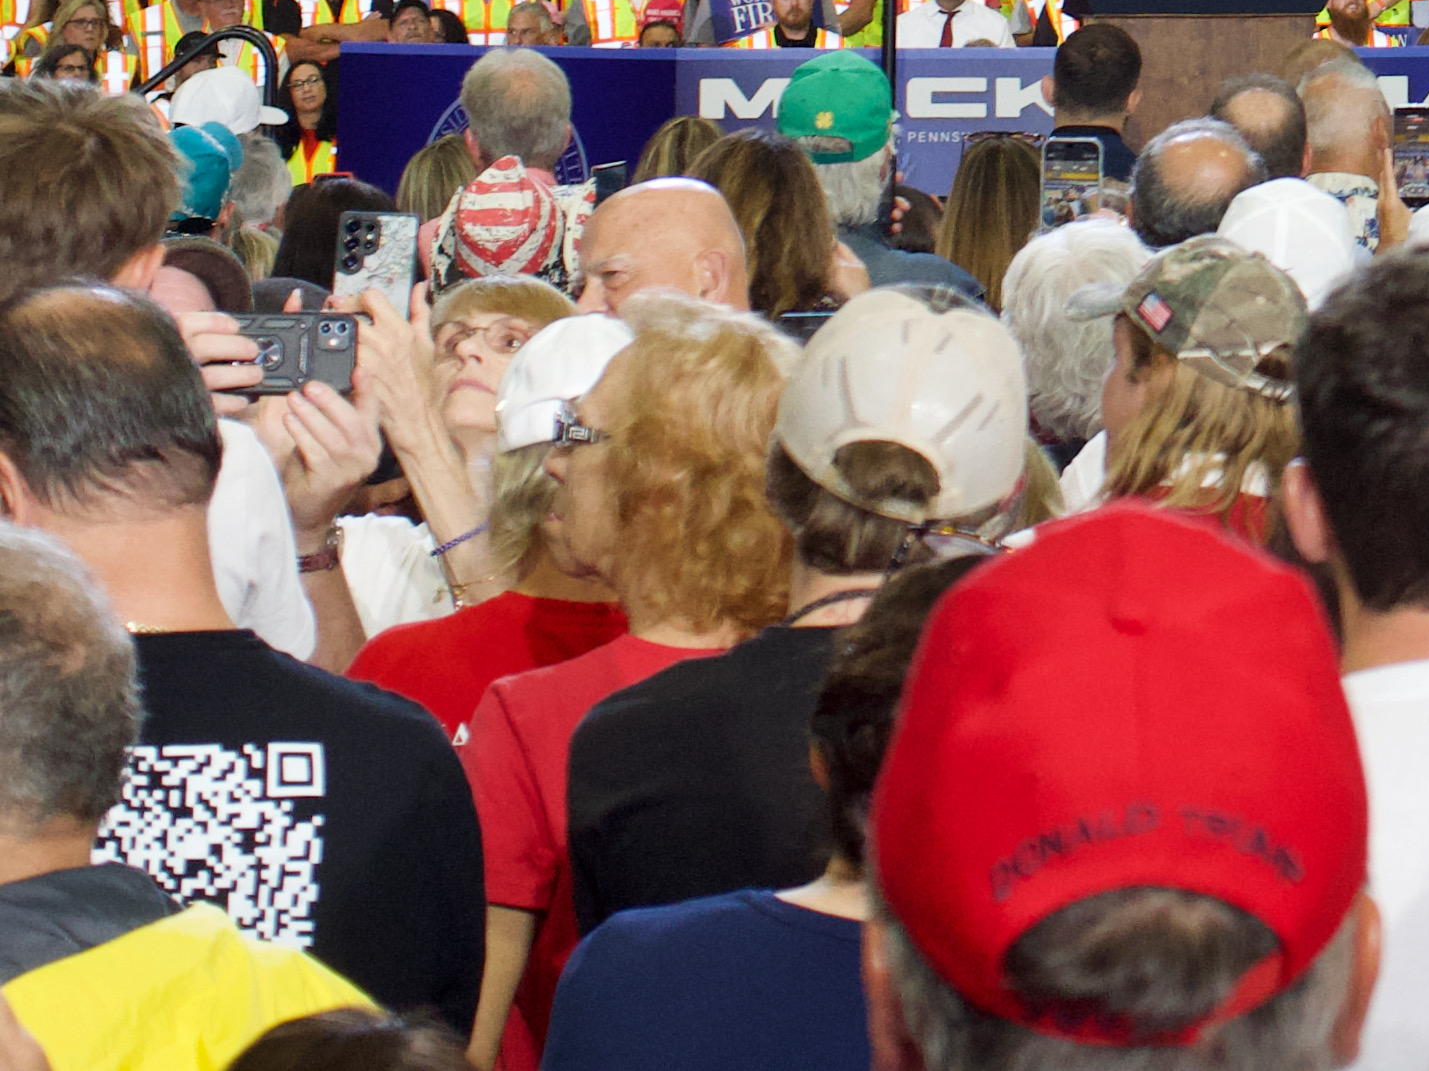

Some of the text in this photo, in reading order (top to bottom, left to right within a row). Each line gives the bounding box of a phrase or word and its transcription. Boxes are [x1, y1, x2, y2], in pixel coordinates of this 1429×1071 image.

[730, 1, 774, 33] FIR
[699, 77, 1055, 119] MCK
[907, 131, 968, 143] PENNS
